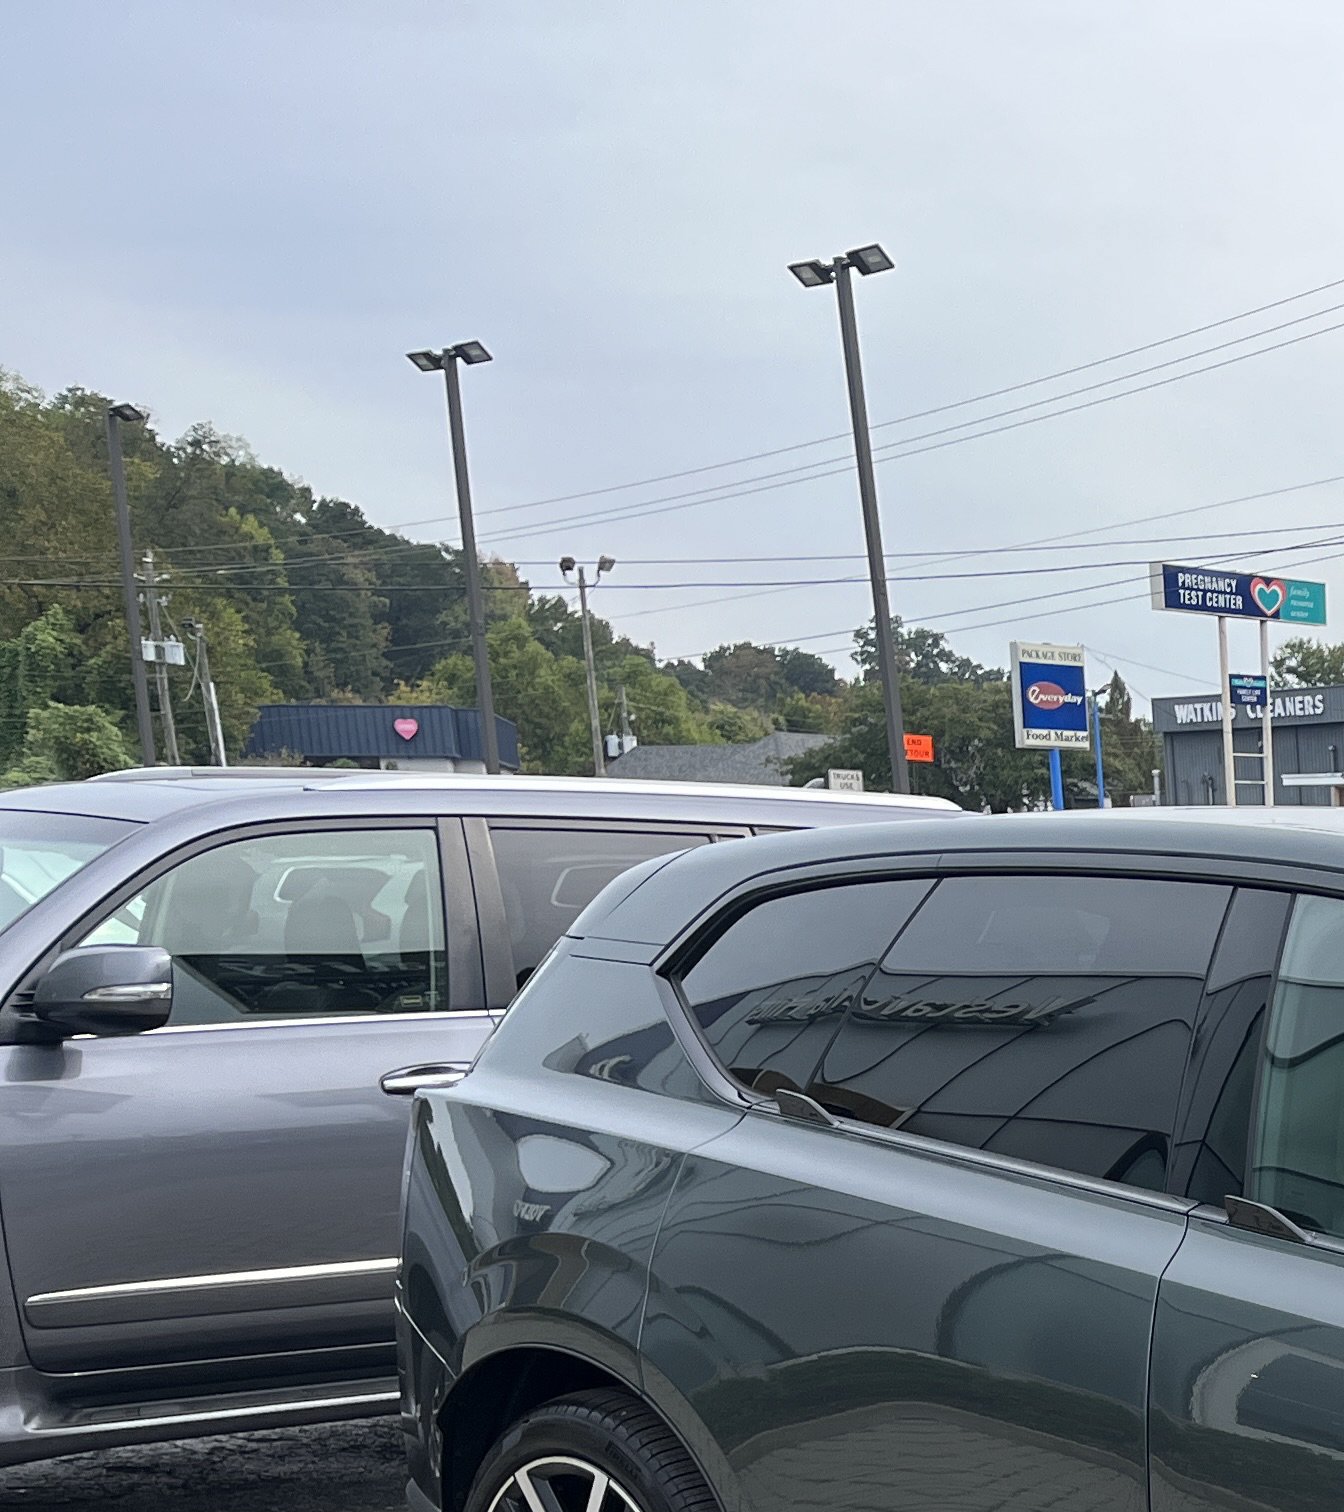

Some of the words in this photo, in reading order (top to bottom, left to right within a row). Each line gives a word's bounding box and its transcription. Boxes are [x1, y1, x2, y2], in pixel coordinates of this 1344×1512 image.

[1178, 573, 1237, 593] PREGNANCY
[1178, 589, 1203, 605] TEST
[1206, 592, 1243, 610] CENTER
[1021, 649, 1055, 660] PACKAGE
[1058, 652, 1082, 662] STORE
[1026, 730, 1051, 741] Food
